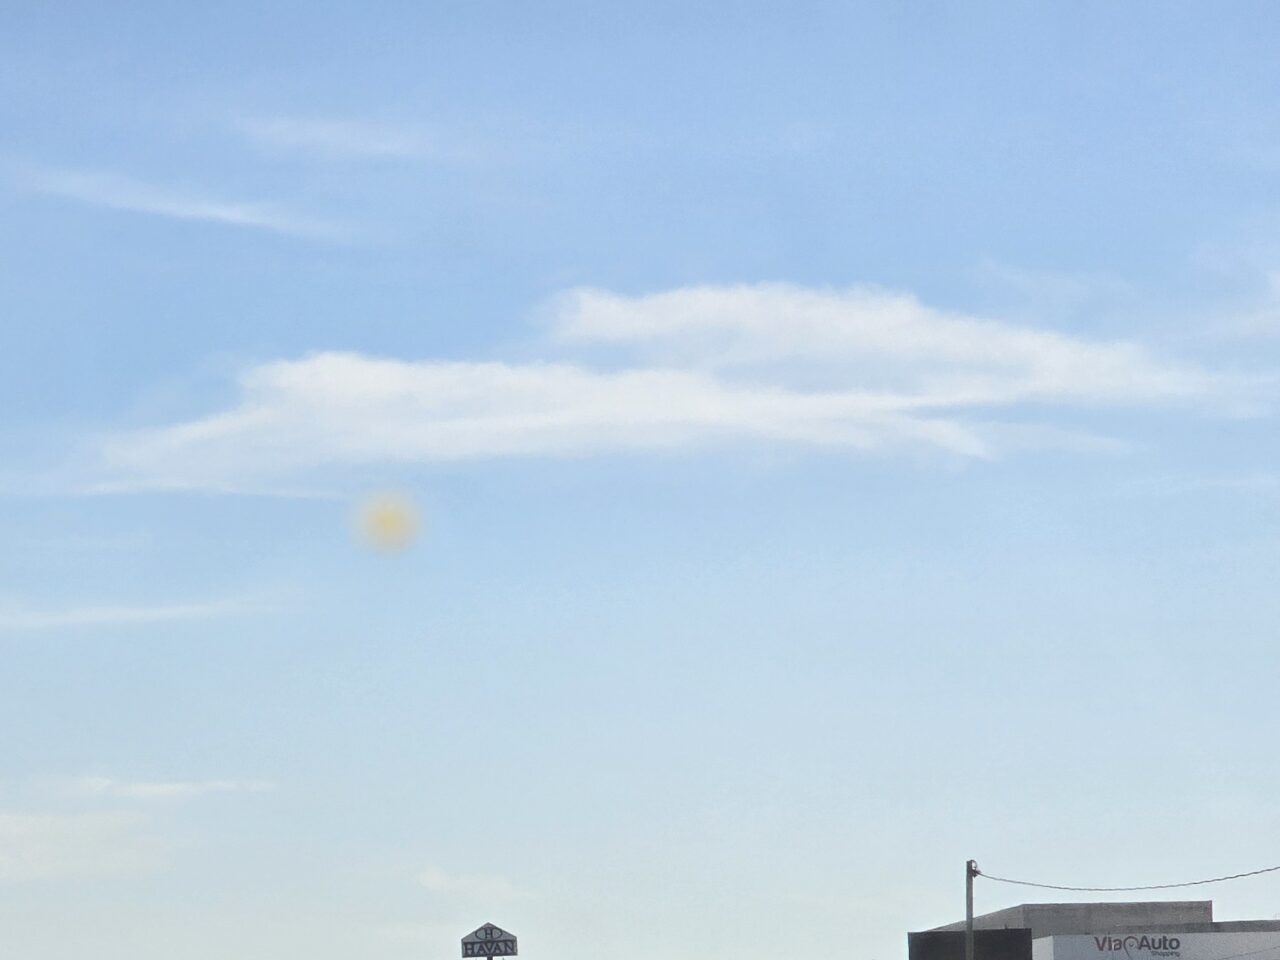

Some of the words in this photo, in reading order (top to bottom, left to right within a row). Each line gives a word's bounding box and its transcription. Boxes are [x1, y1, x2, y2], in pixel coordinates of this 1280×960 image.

[464, 941, 515, 955] HAVAN
[1094, 935, 1122, 951] Via
[1139, 935, 1180, 951] Auto
